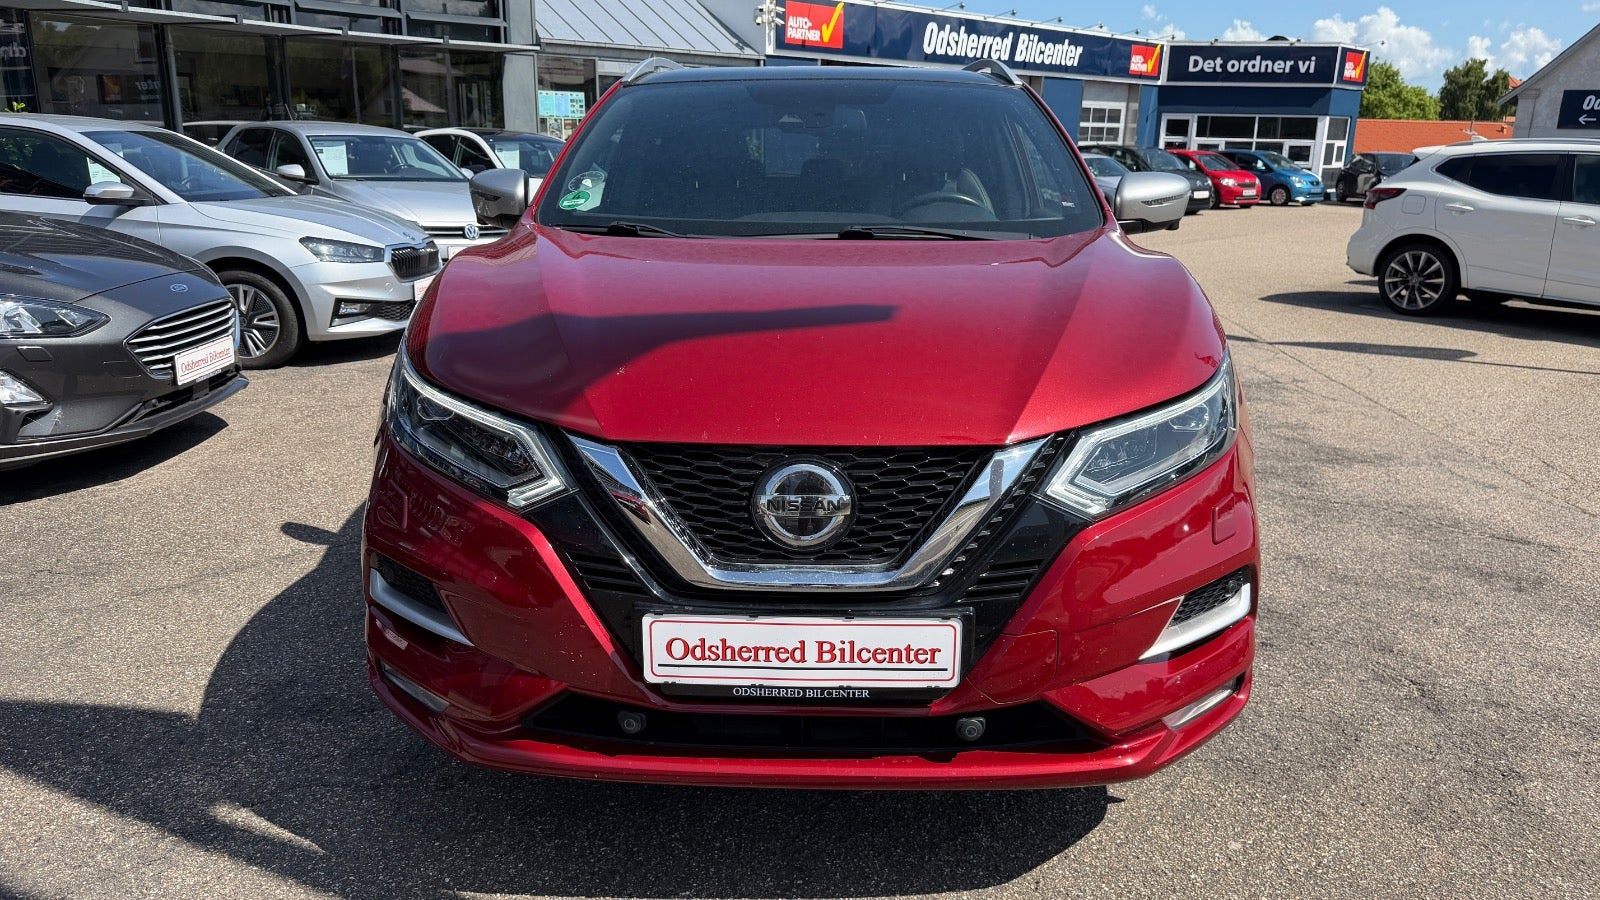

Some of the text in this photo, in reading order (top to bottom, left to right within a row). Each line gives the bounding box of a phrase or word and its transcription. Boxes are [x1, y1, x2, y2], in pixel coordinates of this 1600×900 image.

[787, 16, 813, 29] AUTO-
[786, 28, 821, 42] PARTNER
[923, 21, 1083, 67] Odsherred Bilcenter
[1188, 55, 1316, 74] Det ordner vi
[766, 498, 842, 513] NISSAN
[665, 637, 941, 665] Odsherred Bilcenter
[732, 687, 870, 698] ODSHERRED BILCENTER
